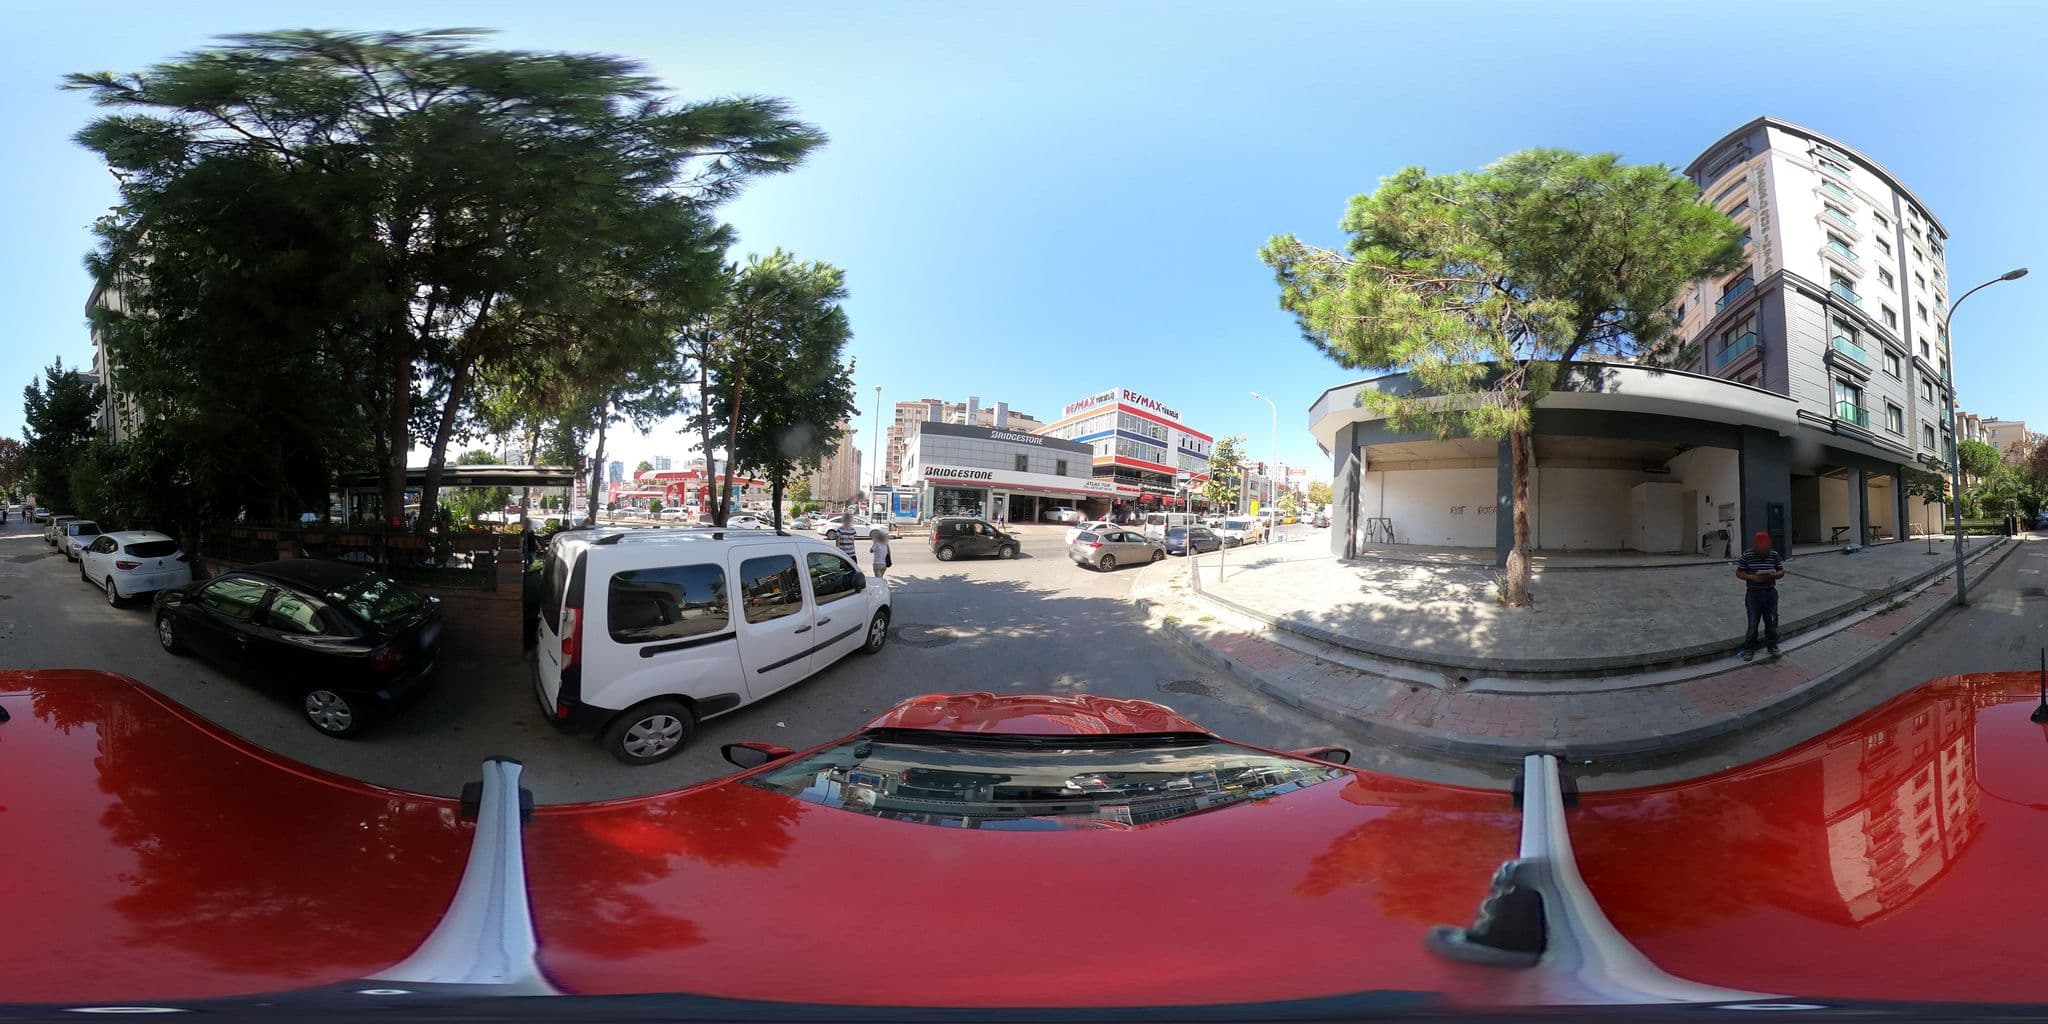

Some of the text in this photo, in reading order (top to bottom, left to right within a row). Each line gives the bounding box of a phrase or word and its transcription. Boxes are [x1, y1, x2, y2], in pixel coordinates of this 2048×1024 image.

[1065, 396, 1096, 415] RE/MAX
[1123, 389, 1162, 413] RE/MAX
[990, 430, 1044, 445] BRIDGESTONE
[924, 466, 993, 480] BRIDGESTONE
